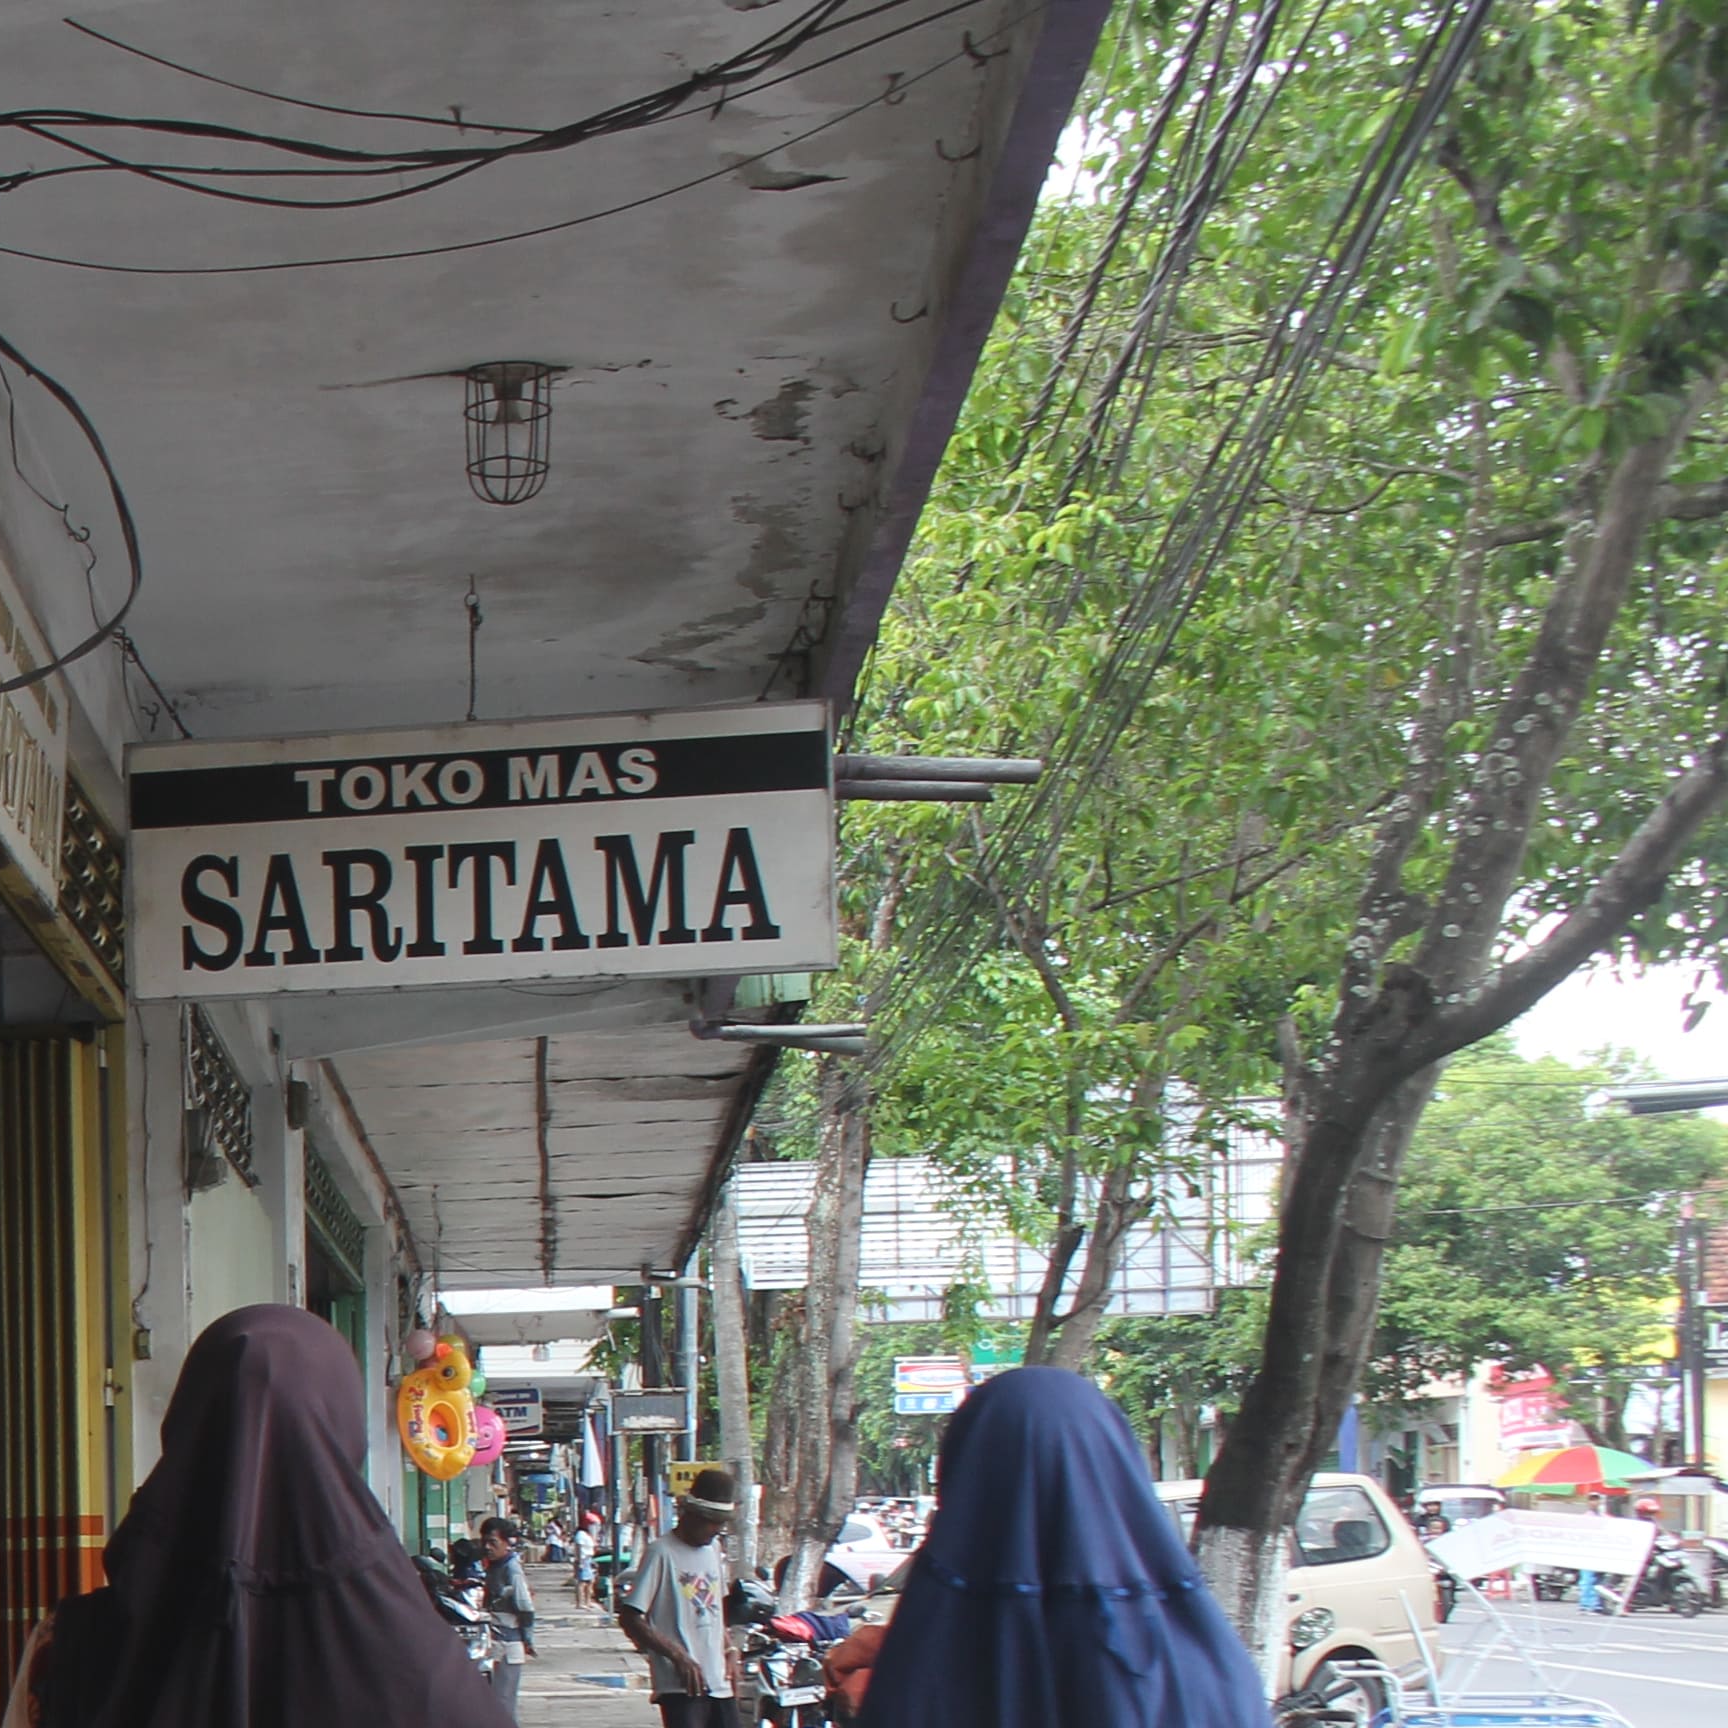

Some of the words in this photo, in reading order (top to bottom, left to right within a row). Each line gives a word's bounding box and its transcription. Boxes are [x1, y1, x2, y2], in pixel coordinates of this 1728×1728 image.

[295, 760, 484, 813] TOKO
[508, 748, 659, 801] MAS
[181, 827, 782, 972] SARITAMA
